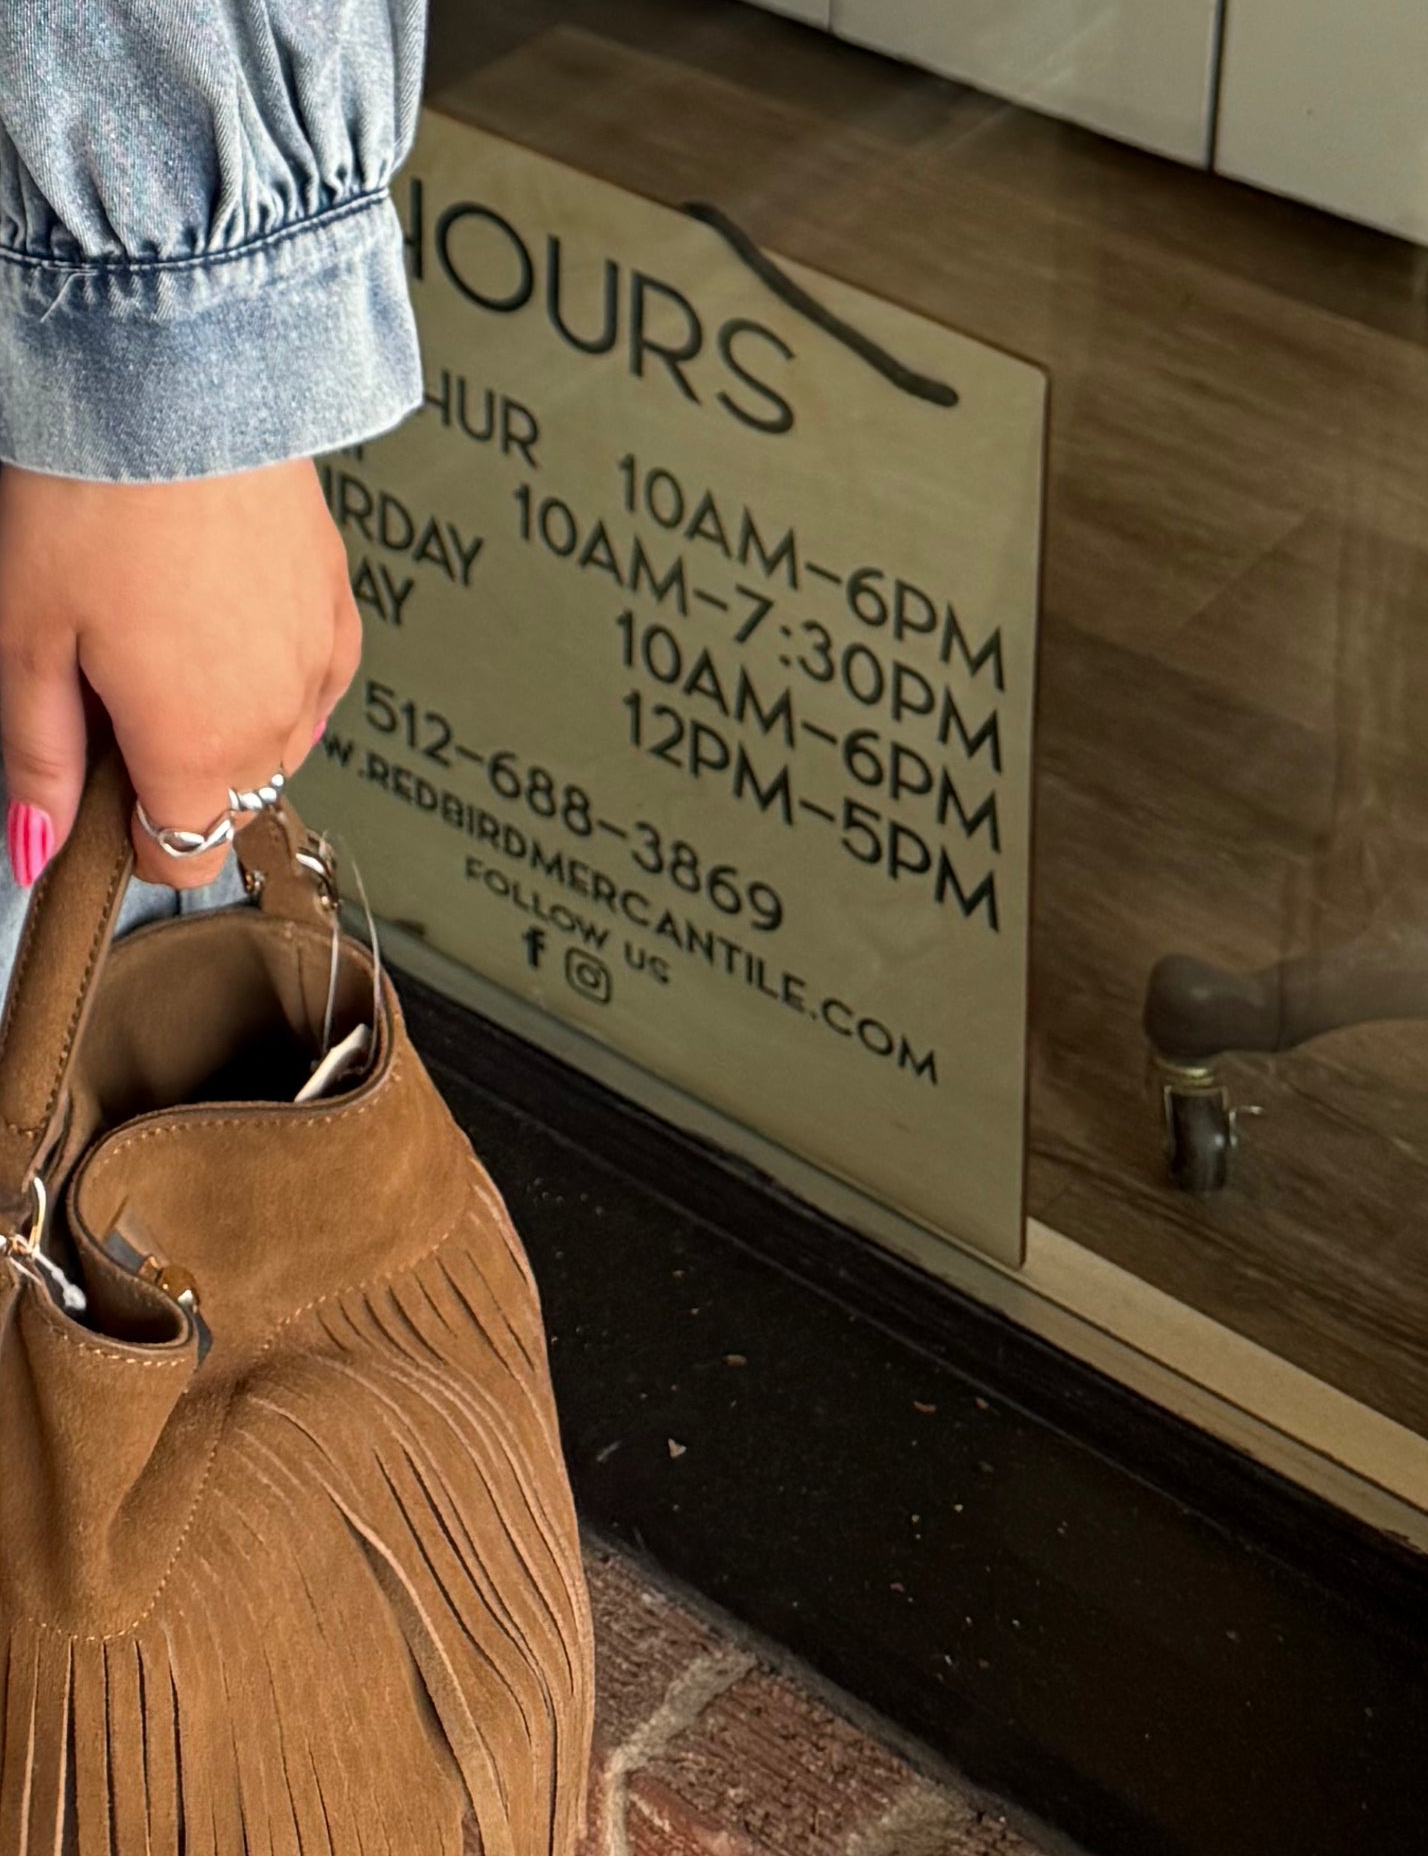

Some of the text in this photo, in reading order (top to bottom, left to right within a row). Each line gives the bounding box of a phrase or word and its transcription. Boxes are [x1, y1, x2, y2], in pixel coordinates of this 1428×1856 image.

[514, 484, 1001, 774] 10AM-7:30PM
[619, 454, 1004, 691] 10AM-6PM
[365, 680, 783, 932] 512-688-3869
[617, 610, 1001, 853] 10AM-6PM
[623, 690, 999, 933] 12PM-5PM
[465, 856, 670, 985] FOLLOW US
